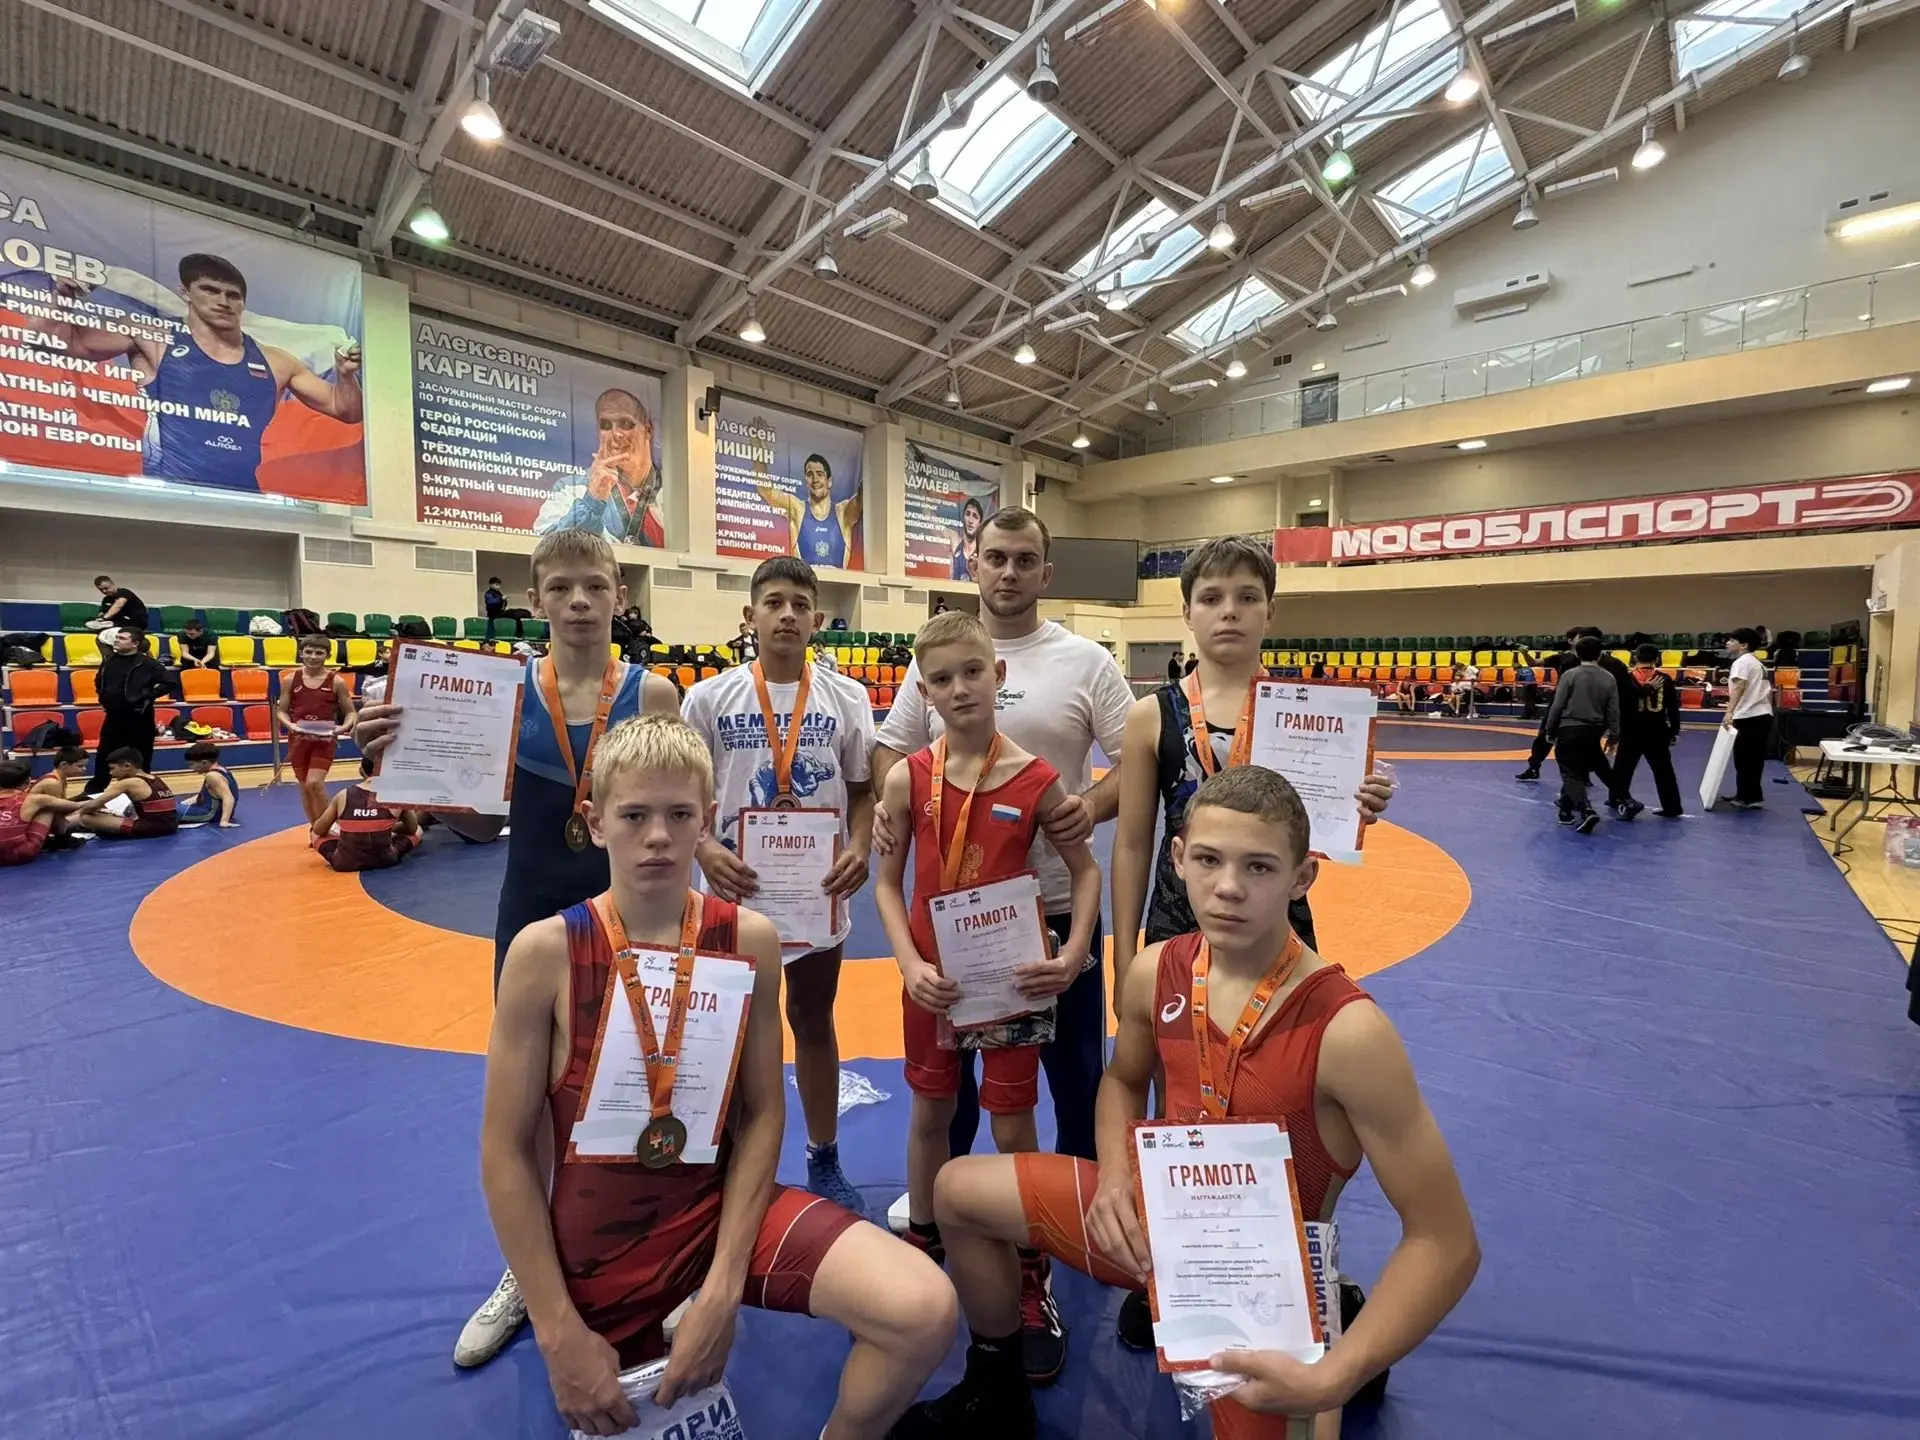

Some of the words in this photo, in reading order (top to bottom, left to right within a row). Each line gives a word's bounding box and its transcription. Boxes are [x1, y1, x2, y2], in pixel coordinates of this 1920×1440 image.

[0, 237, 107, 285] ОЕВ
[57, 294, 126, 319] МАСТЕР
[130, 312, 191, 334] СПОРТА
[106, 321, 175, 345] БОРЬБЕ
[417, 323, 555, 377] Александр
[104, 364, 146, 382] ИГР
[417, 350, 539, 396] КАРЕЛИН
[83, 387, 189, 418] ЧЕМПИОН
[195, 406, 252, 429] МИРА
[418, 381, 495, 404] ЗАСЛУЖЕННЫЙ
[497, 397, 532, 411] МАСТЕР
[533, 405, 567, 419] СПОРТА
[419, 391, 434, 402] ПО
[436, 395, 519, 420] ГРЕКО-РИМСКОЙ
[521, 412, 559, 427] БОРЬБЕ
[0, 416, 38, 437] ОН
[45, 426, 142, 452] ЕВРОПЫ
[420, 408, 461, 425] ГЕРОЙ
[464, 417, 547, 441] РОССИЙСКОЙ
[420, 421, 497, 444] ФЕДЕРАЦИИ
[421, 440, 513, 464] ТРЁХКРАТНЫЙ
[515, 456, 587, 476] ПОБЕДИТЕЛЬ
[422, 453, 519, 477] ОЛИМПИЙСКИХ
[521, 469, 543, 480] ИГР
[422, 474, 494, 492] 9-КРАТНЫЙ
[497, 486, 555, 500] ЧЕМПИОН
[720, 473, 772, 488] ГРЕКО-РИМСКОЙ
[773, 483, 796, 493] БОРЬБЕ
[758, 472, 780, 481] МАСТЕР
[781, 477, 802, 486] СПОРТА
[423, 485, 460, 499] МИРА
[716, 487, 761, 501] ОБЕДИТЕЛЬ
[423, 505, 503, 524] 12-КРАТНЫЙ
[717, 513, 751, 526] ЕМПИОН
[752, 518, 775, 529] МИРА
[772, 507, 787, 516] ИГР
[1332, 489, 1816, 558] МОСОБЛСПОРТ
[718, 539, 751, 550] ЕМПИОН
[752, 542, 785, 554] ЕВРОПЫ
[420, 673, 493, 696] ГРАМОТА
[1275, 712, 1344, 734] ГРАМОТА
[353, 808, 378, 817] RUS
[761, 835, 816, 849] ГРАМОТА
[954, 905, 1019, 933] ГРАМОТА
[643, 985, 717, 1013] ГРАОТА
[1168, 1163, 1257, 1187] ГРАМОТА
